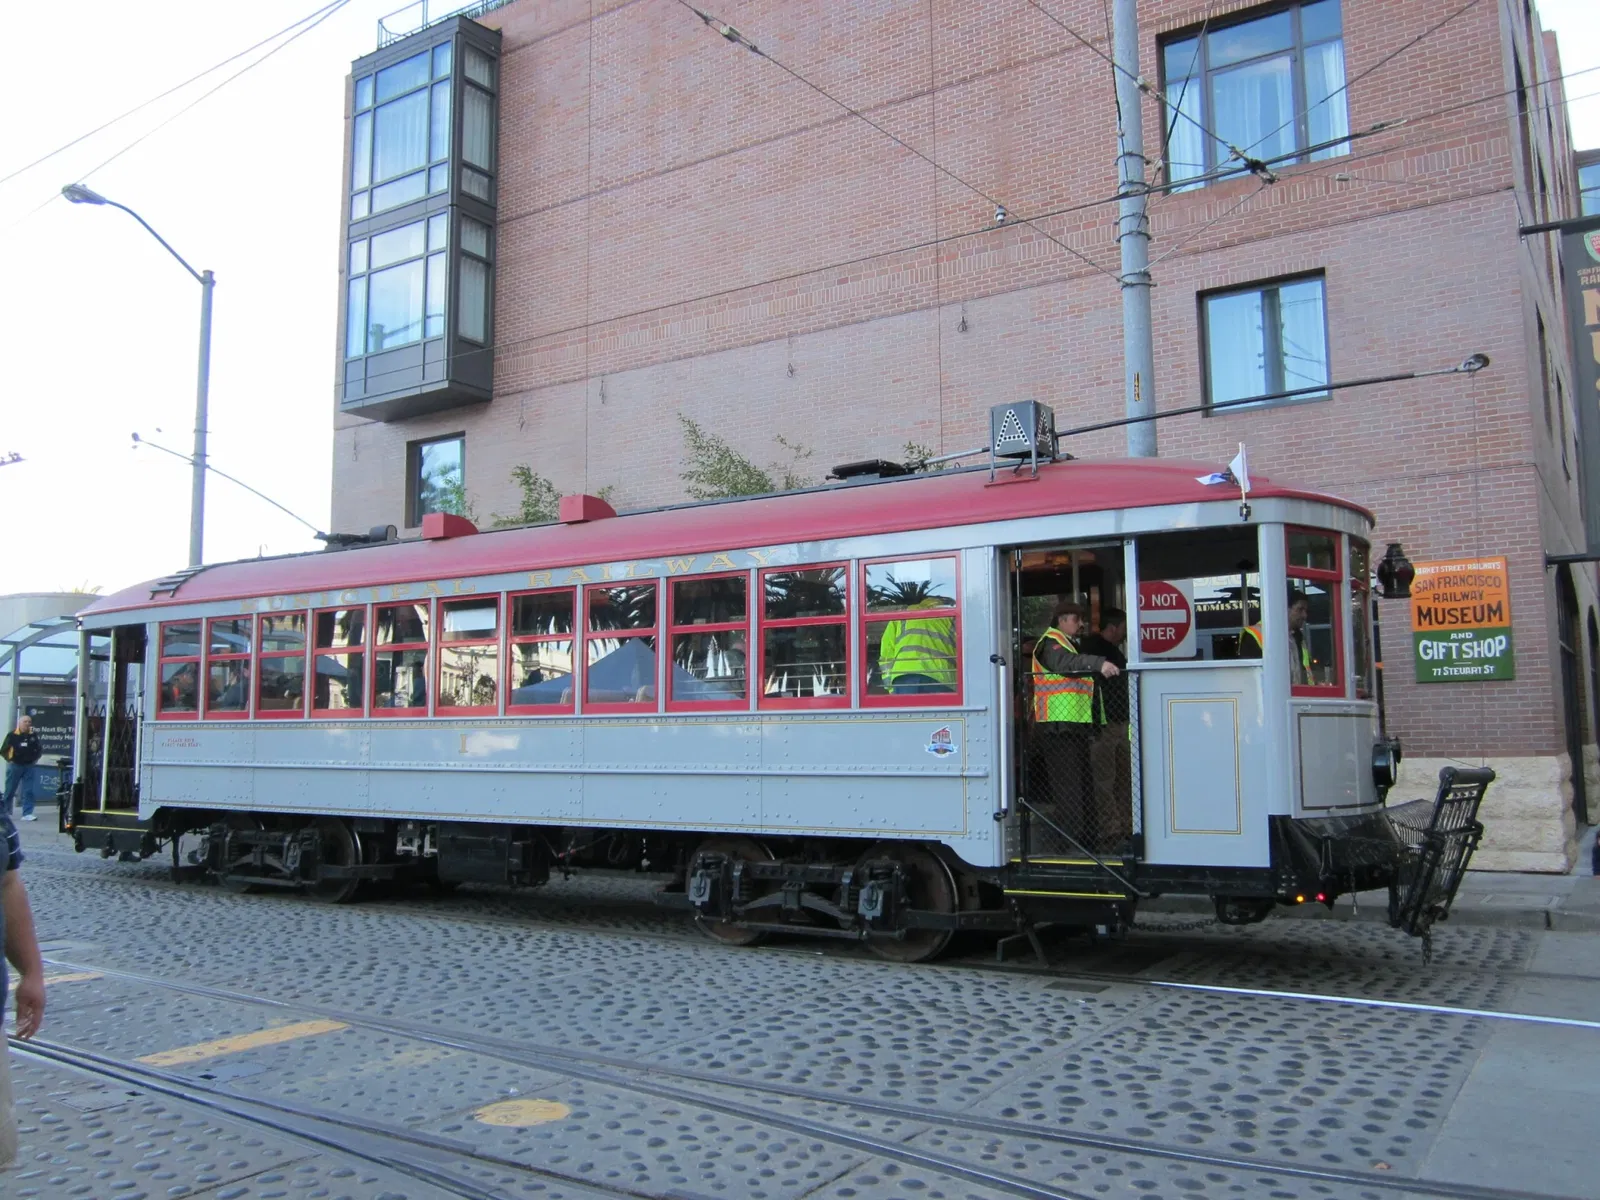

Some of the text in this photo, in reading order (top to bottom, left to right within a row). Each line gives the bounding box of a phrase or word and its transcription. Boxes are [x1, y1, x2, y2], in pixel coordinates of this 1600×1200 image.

[995, 409, 1031, 450] A
[1440, 564, 1465, 572] STREET
[240, 549, 781, 612] MUNICIPAL RAILWAY
[1415, 575, 1502, 594] SAN FRANCISCO
[1151, 593, 1178, 607] NOT
[1433, 590, 1484, 603] RAILWAY
[1195, 600, 1259, 612] ADMISSIN
[1416, 601, 1503, 626] MUSEUM
[1140, 627, 1176, 640] NTER
[1450, 632, 1473, 640] AND
[1419, 635, 1506, 660] GIFT SHOP
[1443, 666, 1482, 675] STEUART
